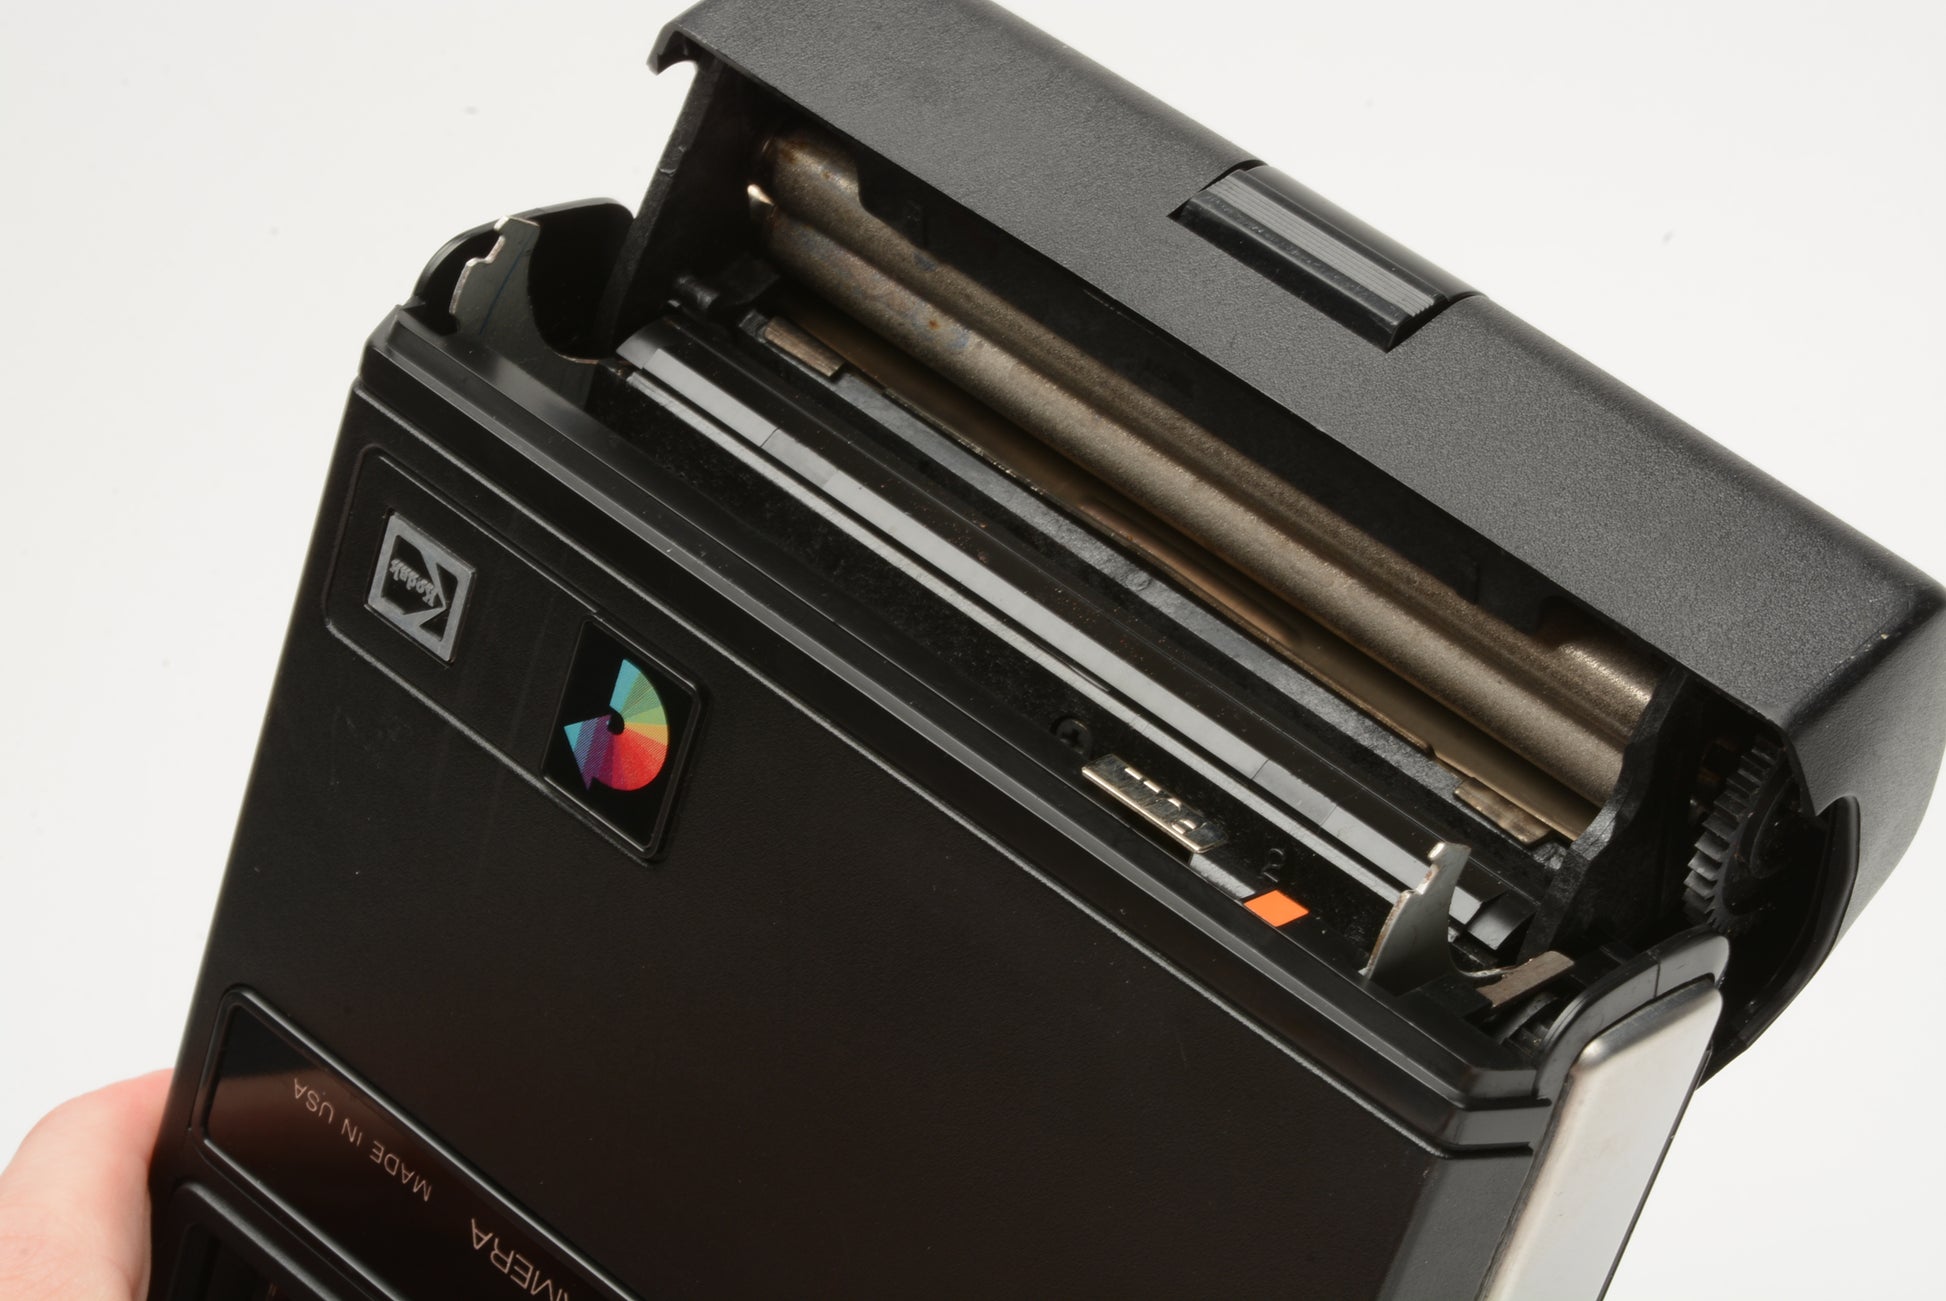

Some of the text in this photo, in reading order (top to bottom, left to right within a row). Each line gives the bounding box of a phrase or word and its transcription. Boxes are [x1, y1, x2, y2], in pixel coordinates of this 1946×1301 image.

[389, 558, 438, 607] Kodak
[294, 1078, 432, 1202] MADE IN USA
[471, 1218, 569, 1301] MERA
